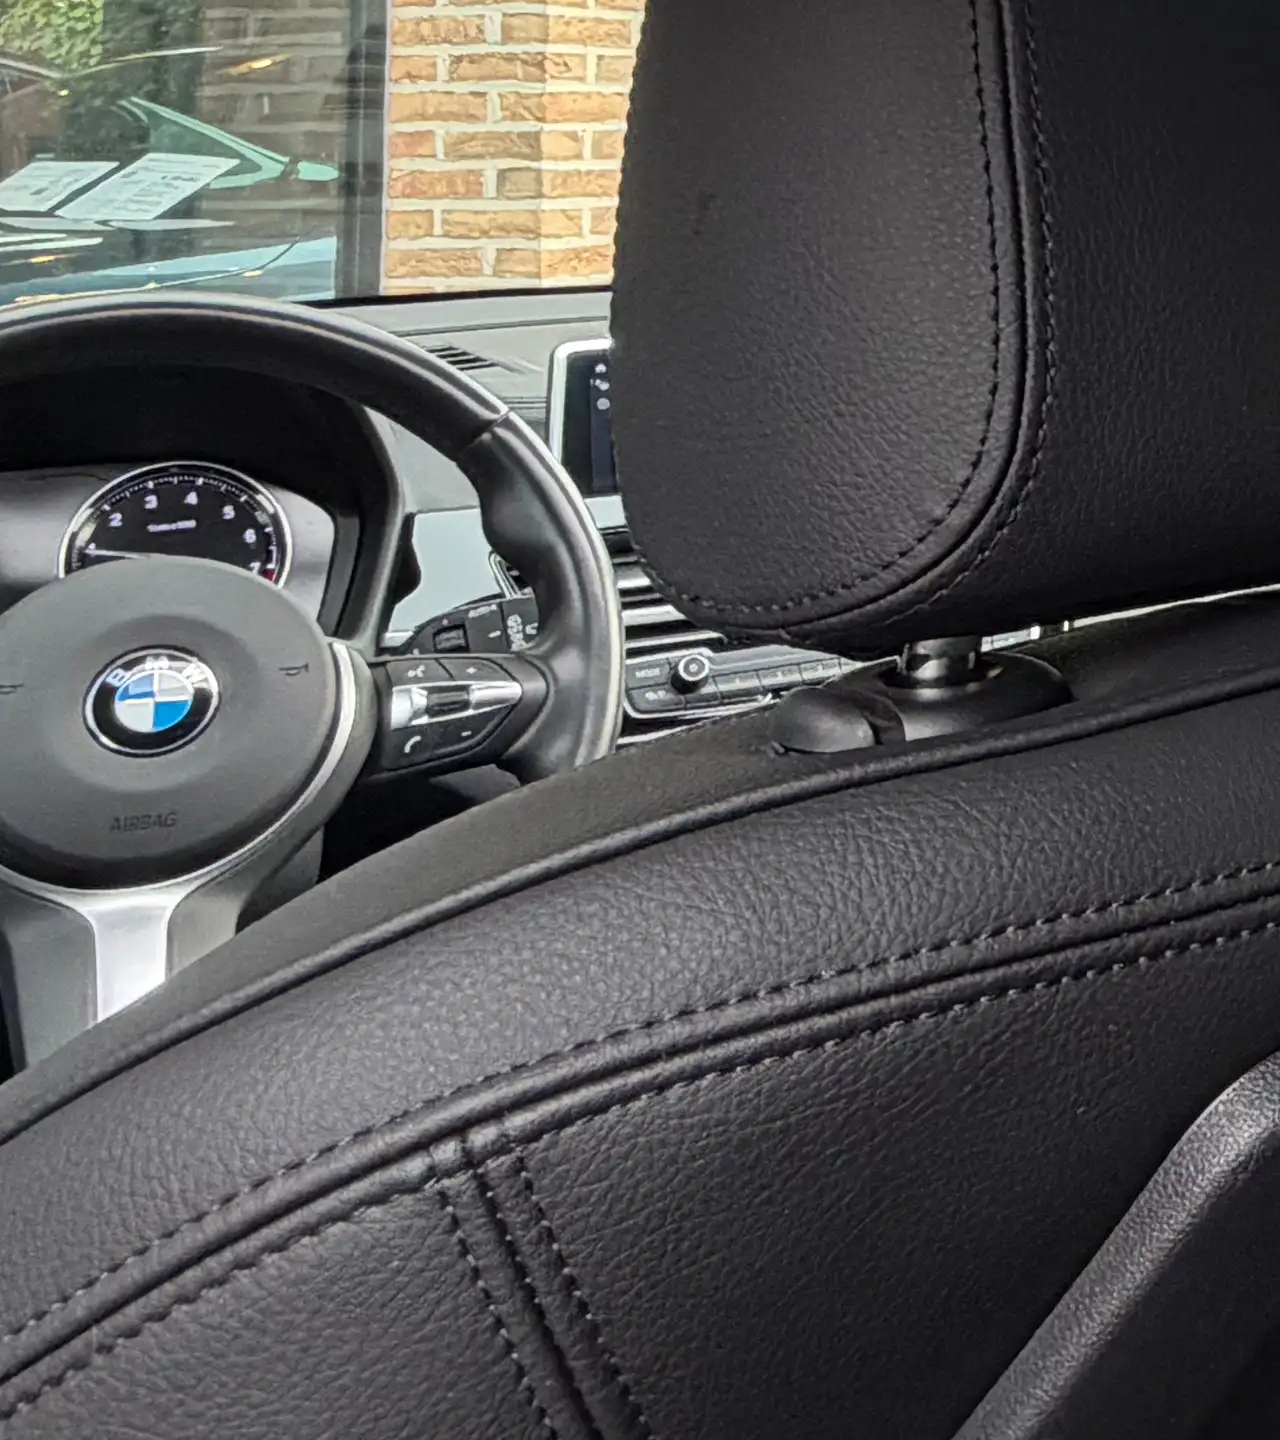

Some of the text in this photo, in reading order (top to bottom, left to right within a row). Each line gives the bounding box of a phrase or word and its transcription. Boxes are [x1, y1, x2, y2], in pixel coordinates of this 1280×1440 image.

[144, 494, 158, 510] 3
[184, 491, 198, 506] 4
[108, 512, 123, 527] 2
[222, 505, 236, 520] 5
[242, 528, 257, 544] 6
[104, 656, 212, 689] BMW
[110, 812, 178, 832] AIRBAG
